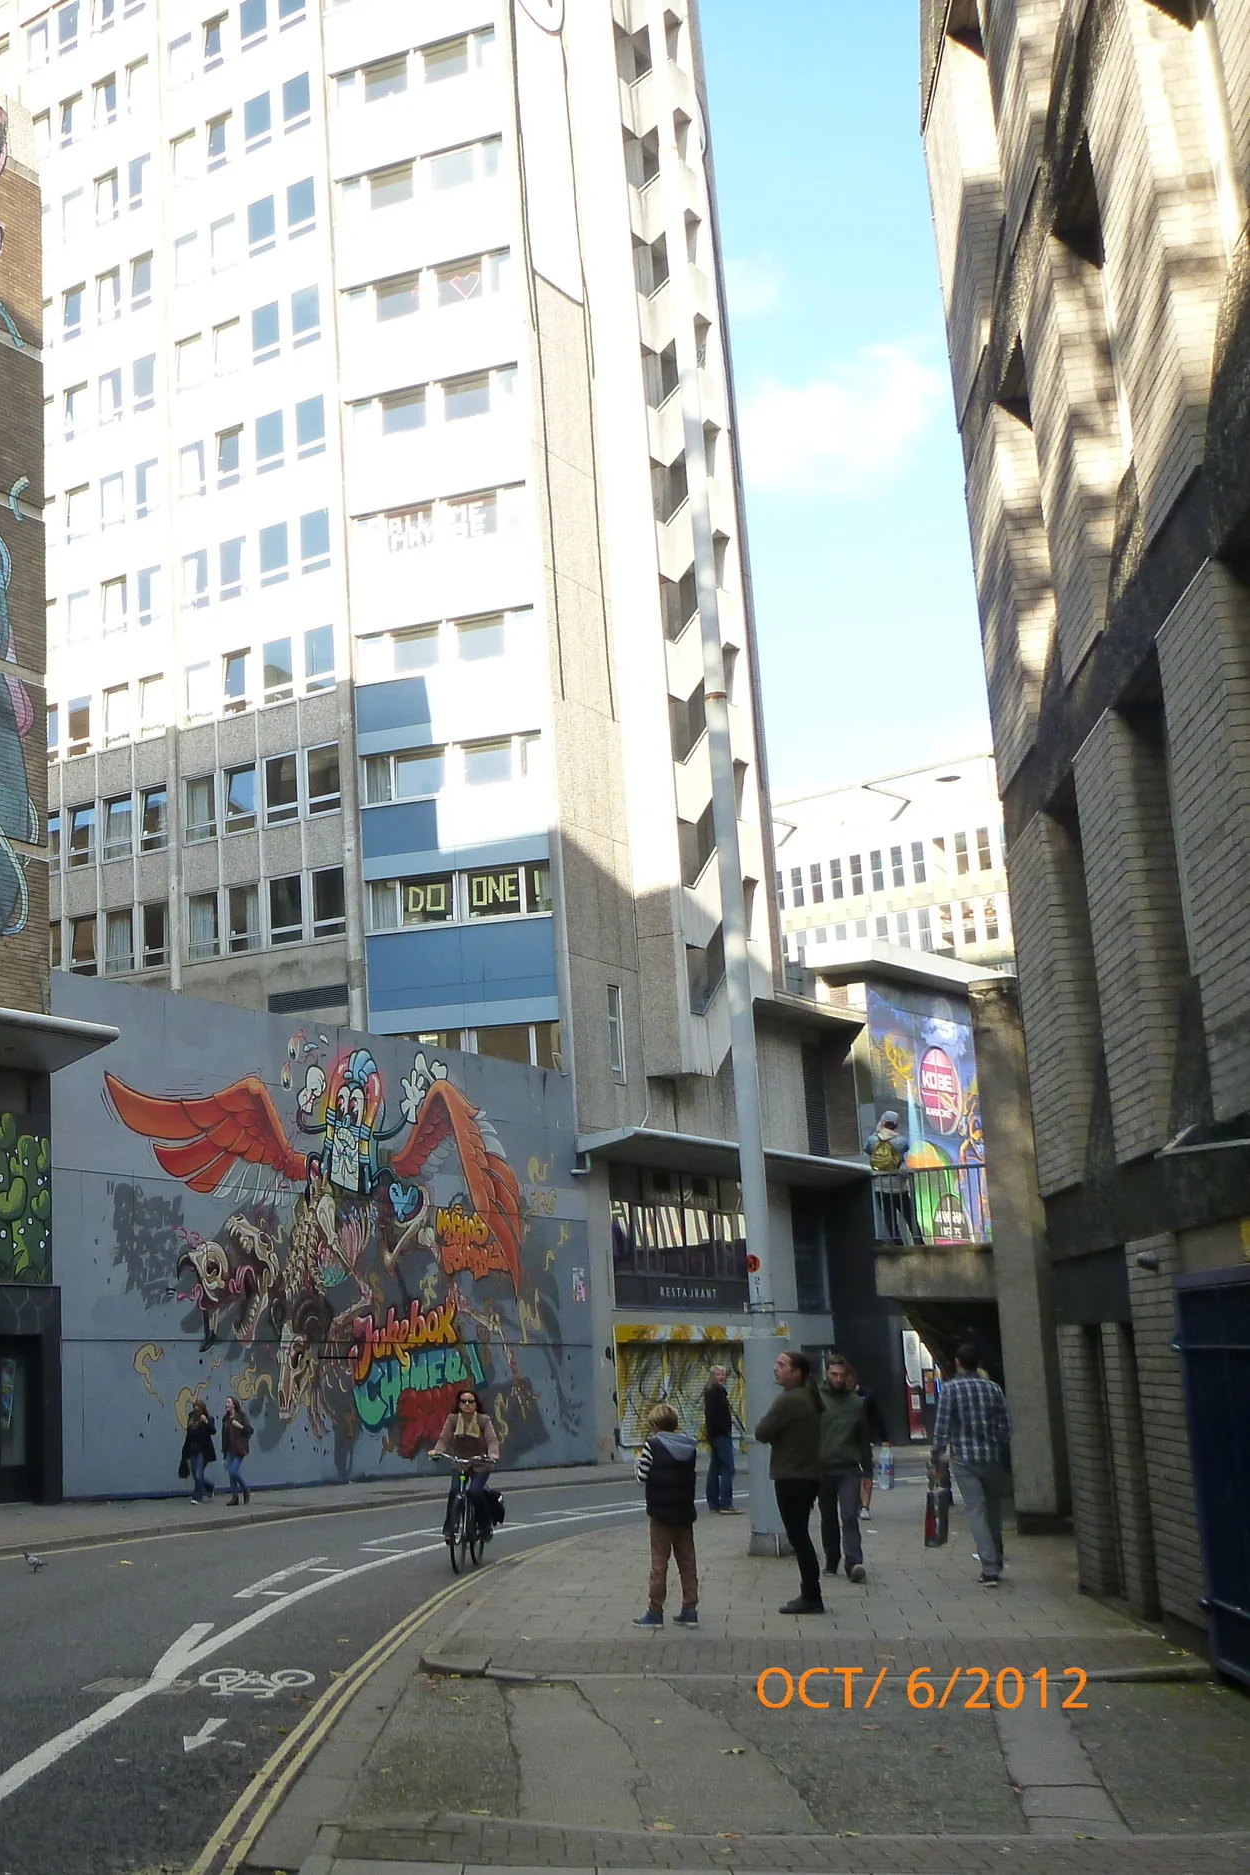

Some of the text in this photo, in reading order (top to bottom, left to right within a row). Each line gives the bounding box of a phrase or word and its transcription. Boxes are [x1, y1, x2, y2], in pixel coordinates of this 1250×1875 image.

[408, 884, 446, 912] DO
[922, 1069, 954, 1093] KOBE
[659, 1286, 717, 1298] RESTAURANT
